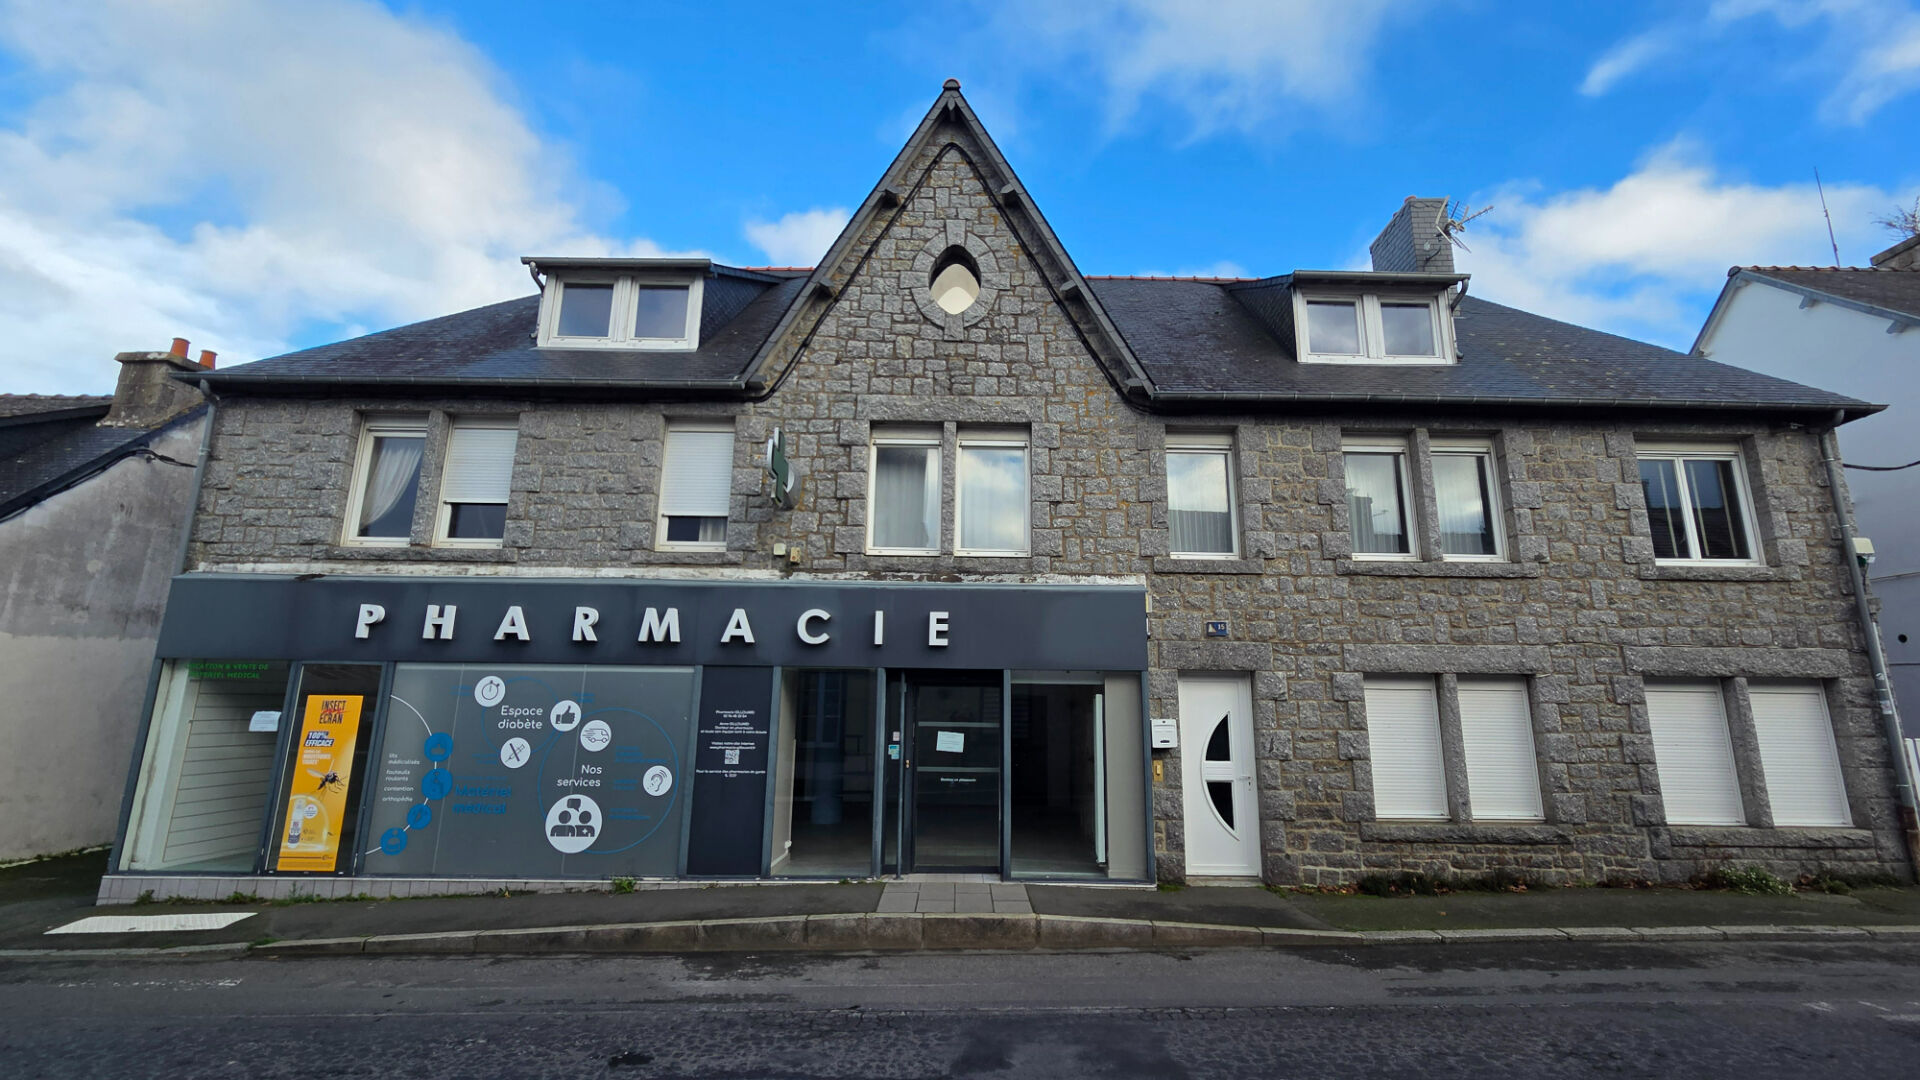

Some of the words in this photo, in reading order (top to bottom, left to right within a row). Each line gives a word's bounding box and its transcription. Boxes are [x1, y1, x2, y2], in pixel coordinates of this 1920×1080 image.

[355, 603, 950, 647] PHARMACIE
[321, 700, 346, 711] INSECT
[500, 705, 543, 717] Espace
[319, 712, 343, 724] ECRAN
[498, 718, 543, 729] diabète
[304, 739, 334, 747] EFFICACE
[581, 764, 602, 775] Nos
[556, 778, 601, 787] services
[455, 784, 511, 797] Matériel
[452, 800, 506, 814] médical
